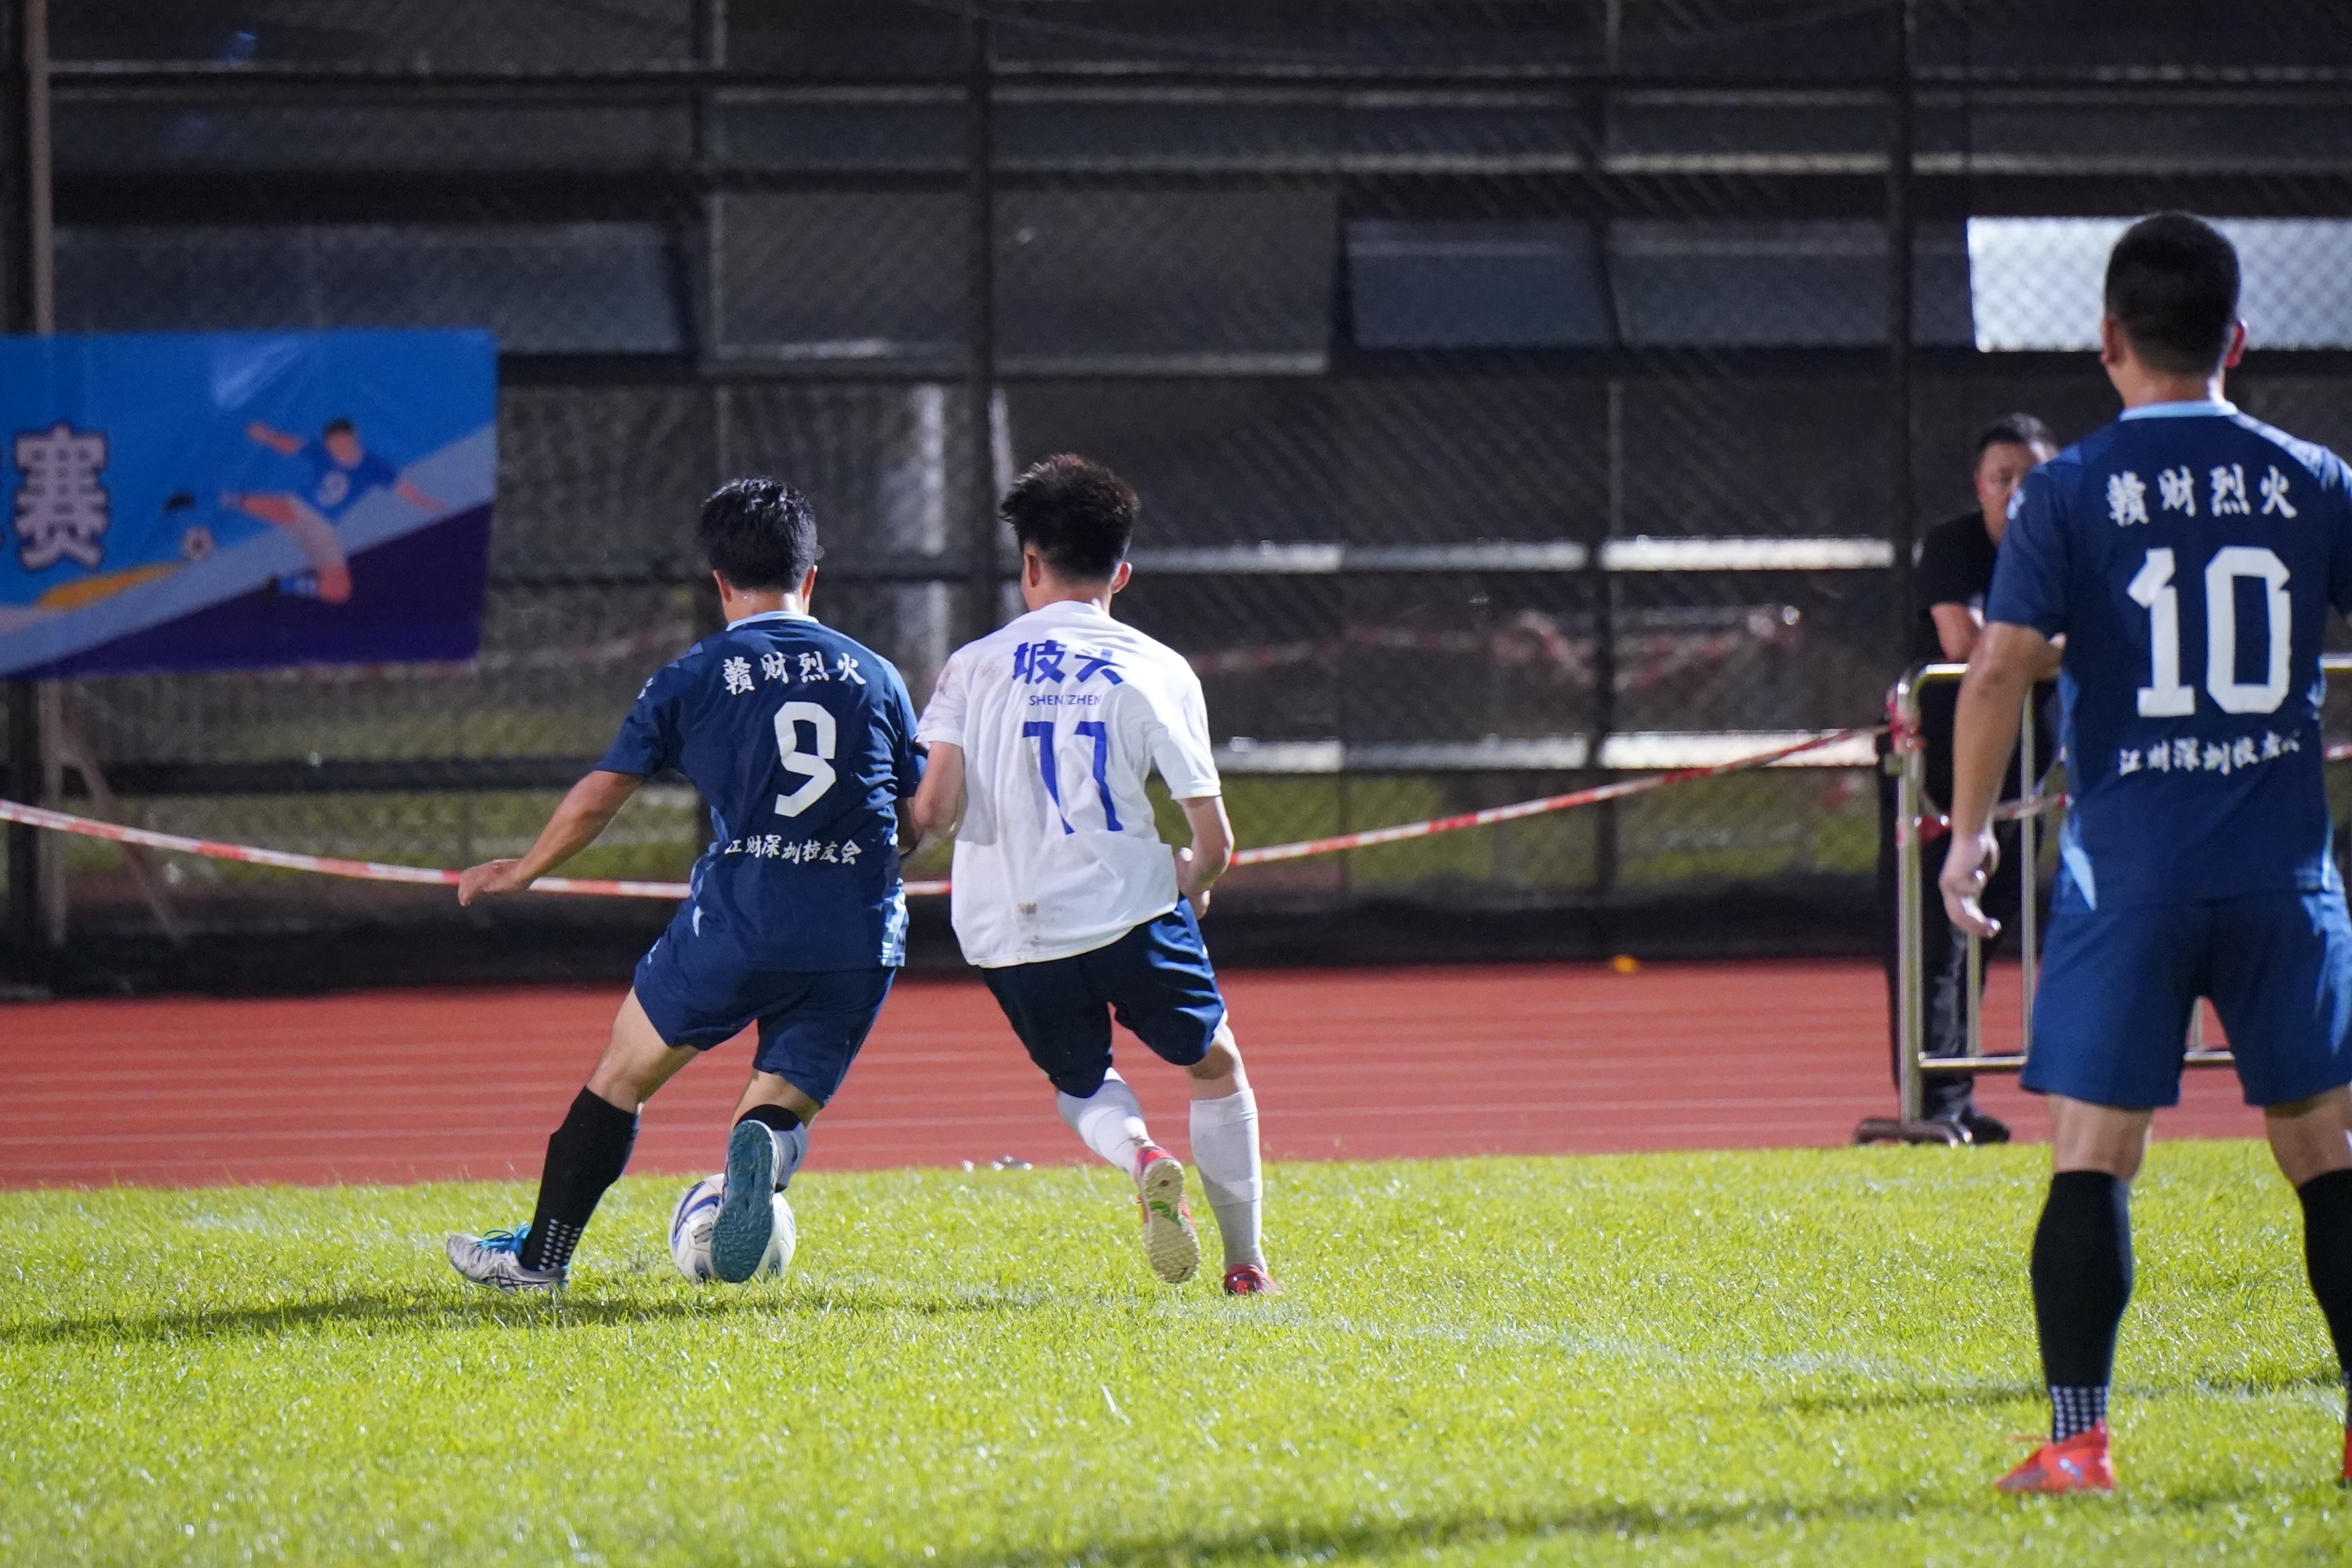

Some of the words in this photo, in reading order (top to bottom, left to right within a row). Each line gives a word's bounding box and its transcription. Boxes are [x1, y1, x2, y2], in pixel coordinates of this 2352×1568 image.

[16, 422, 107, 568] 赛
[722, 650, 867, 696] 赣财烈火
[1012, 640, 1126, 685] 坡头
[2127, 546, 2293, 718] 10
[774, 701, 837, 818] 9
[1022, 721, 1123, 835] 77
